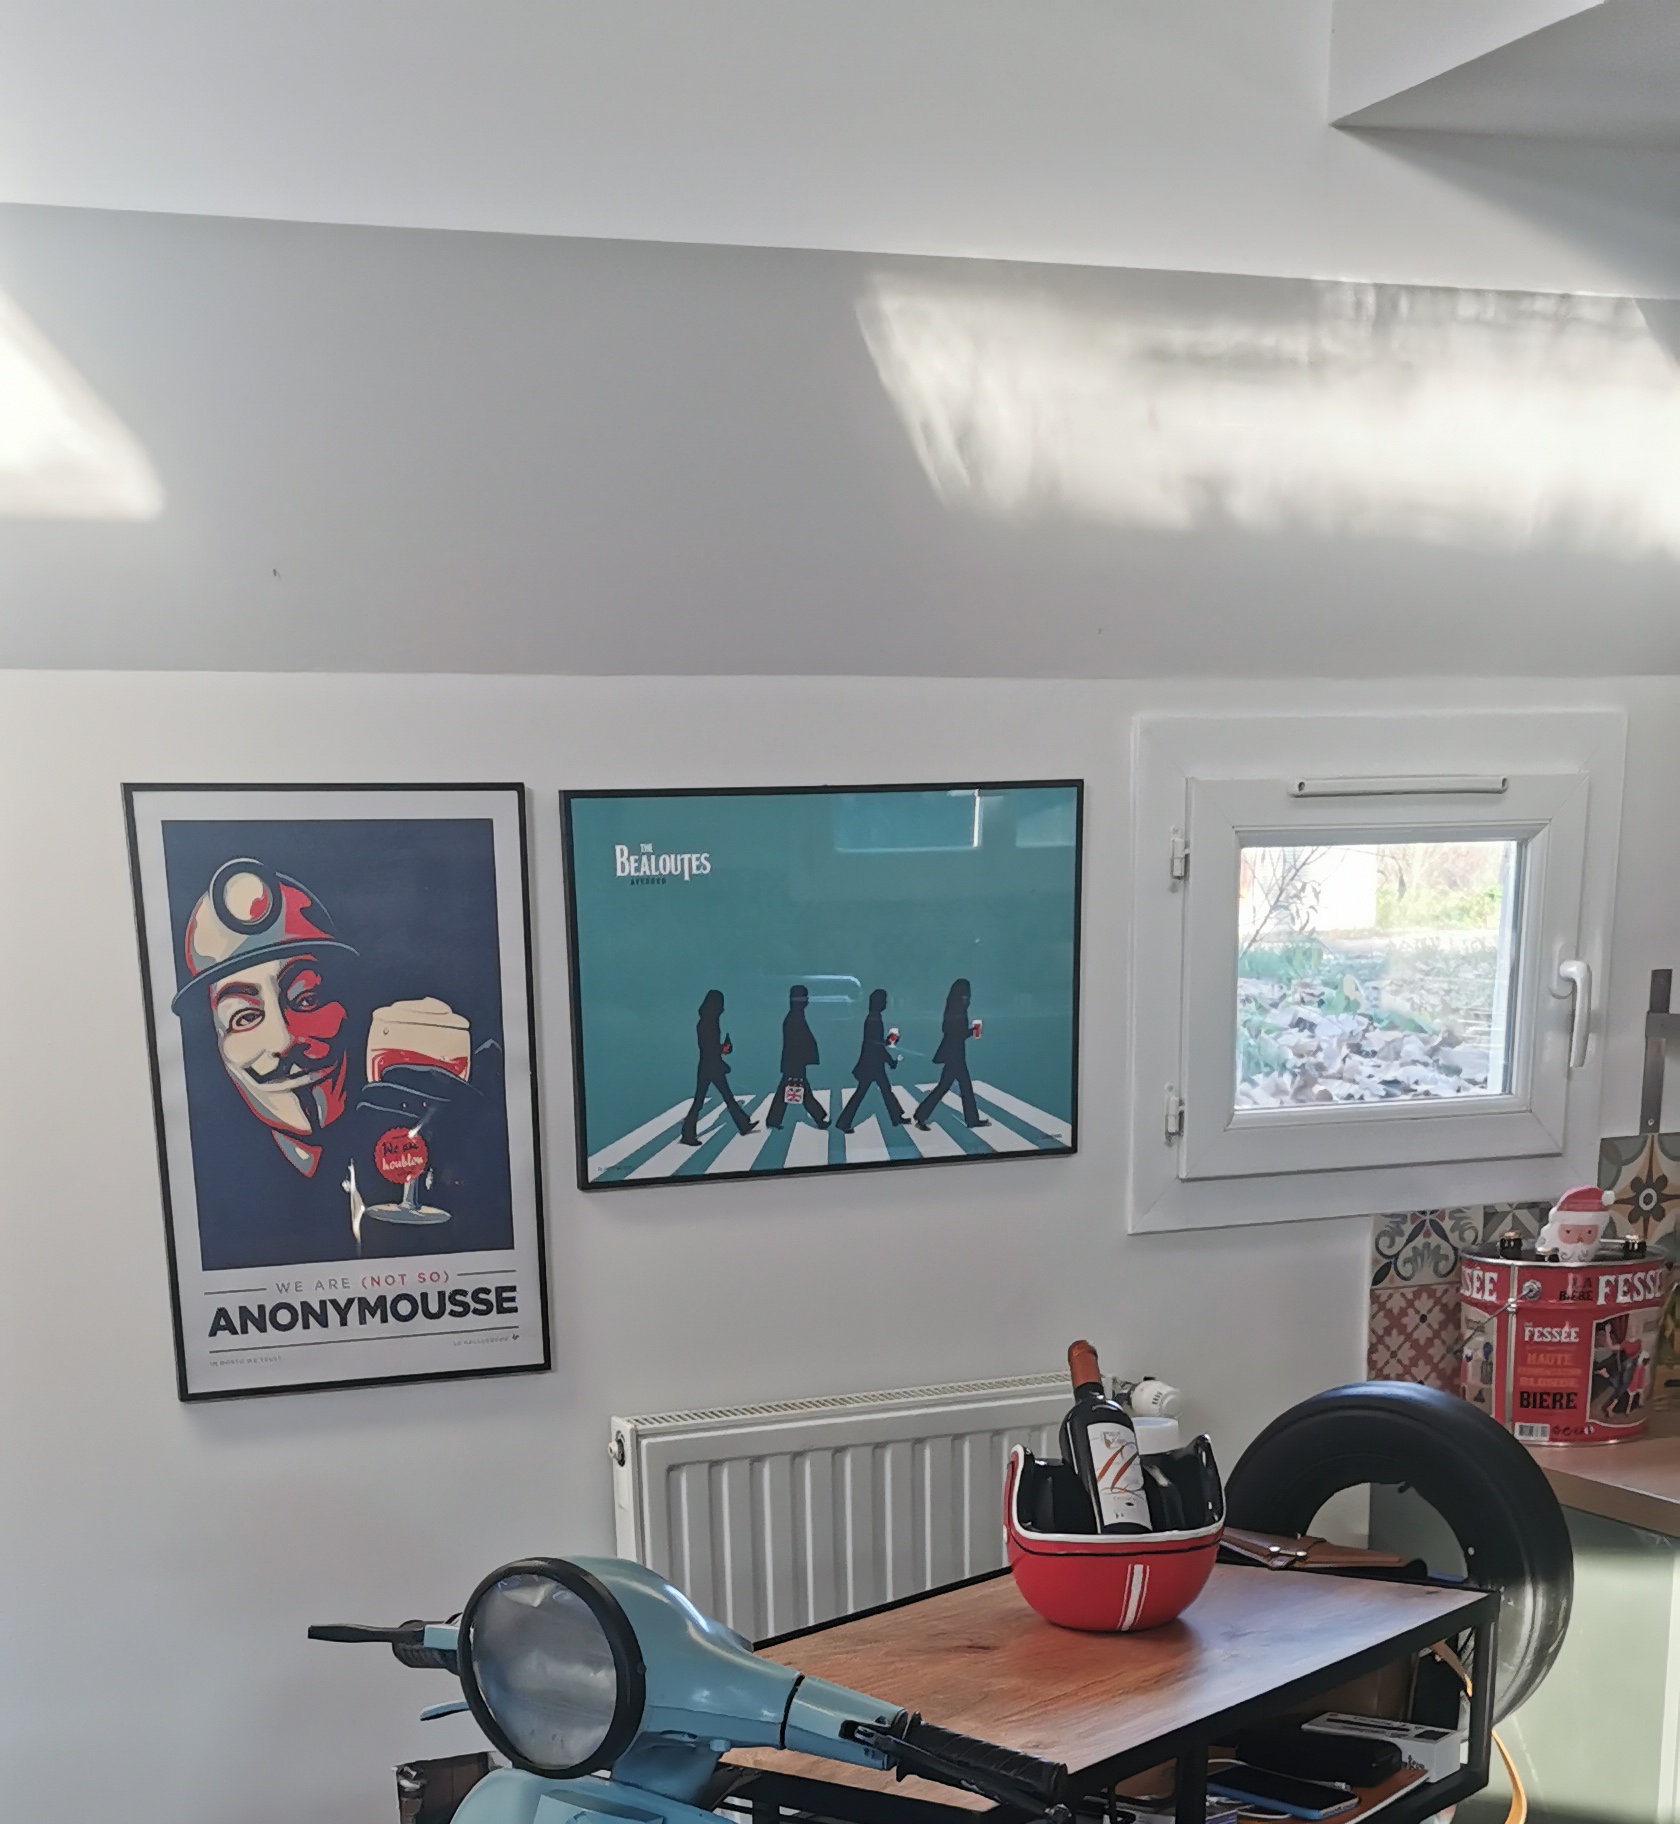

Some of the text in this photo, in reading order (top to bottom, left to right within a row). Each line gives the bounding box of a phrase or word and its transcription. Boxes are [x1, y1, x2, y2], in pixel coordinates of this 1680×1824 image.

[640, 843, 653, 853] THE
[614, 844, 711, 881] BEALOUTES
[275, 1270, 450, 1294] WE ARE (NOT SO)
[208, 1285, 519, 1337] ANONYMOUSSE
[1519, 1391, 1578, 1410] BIERE
